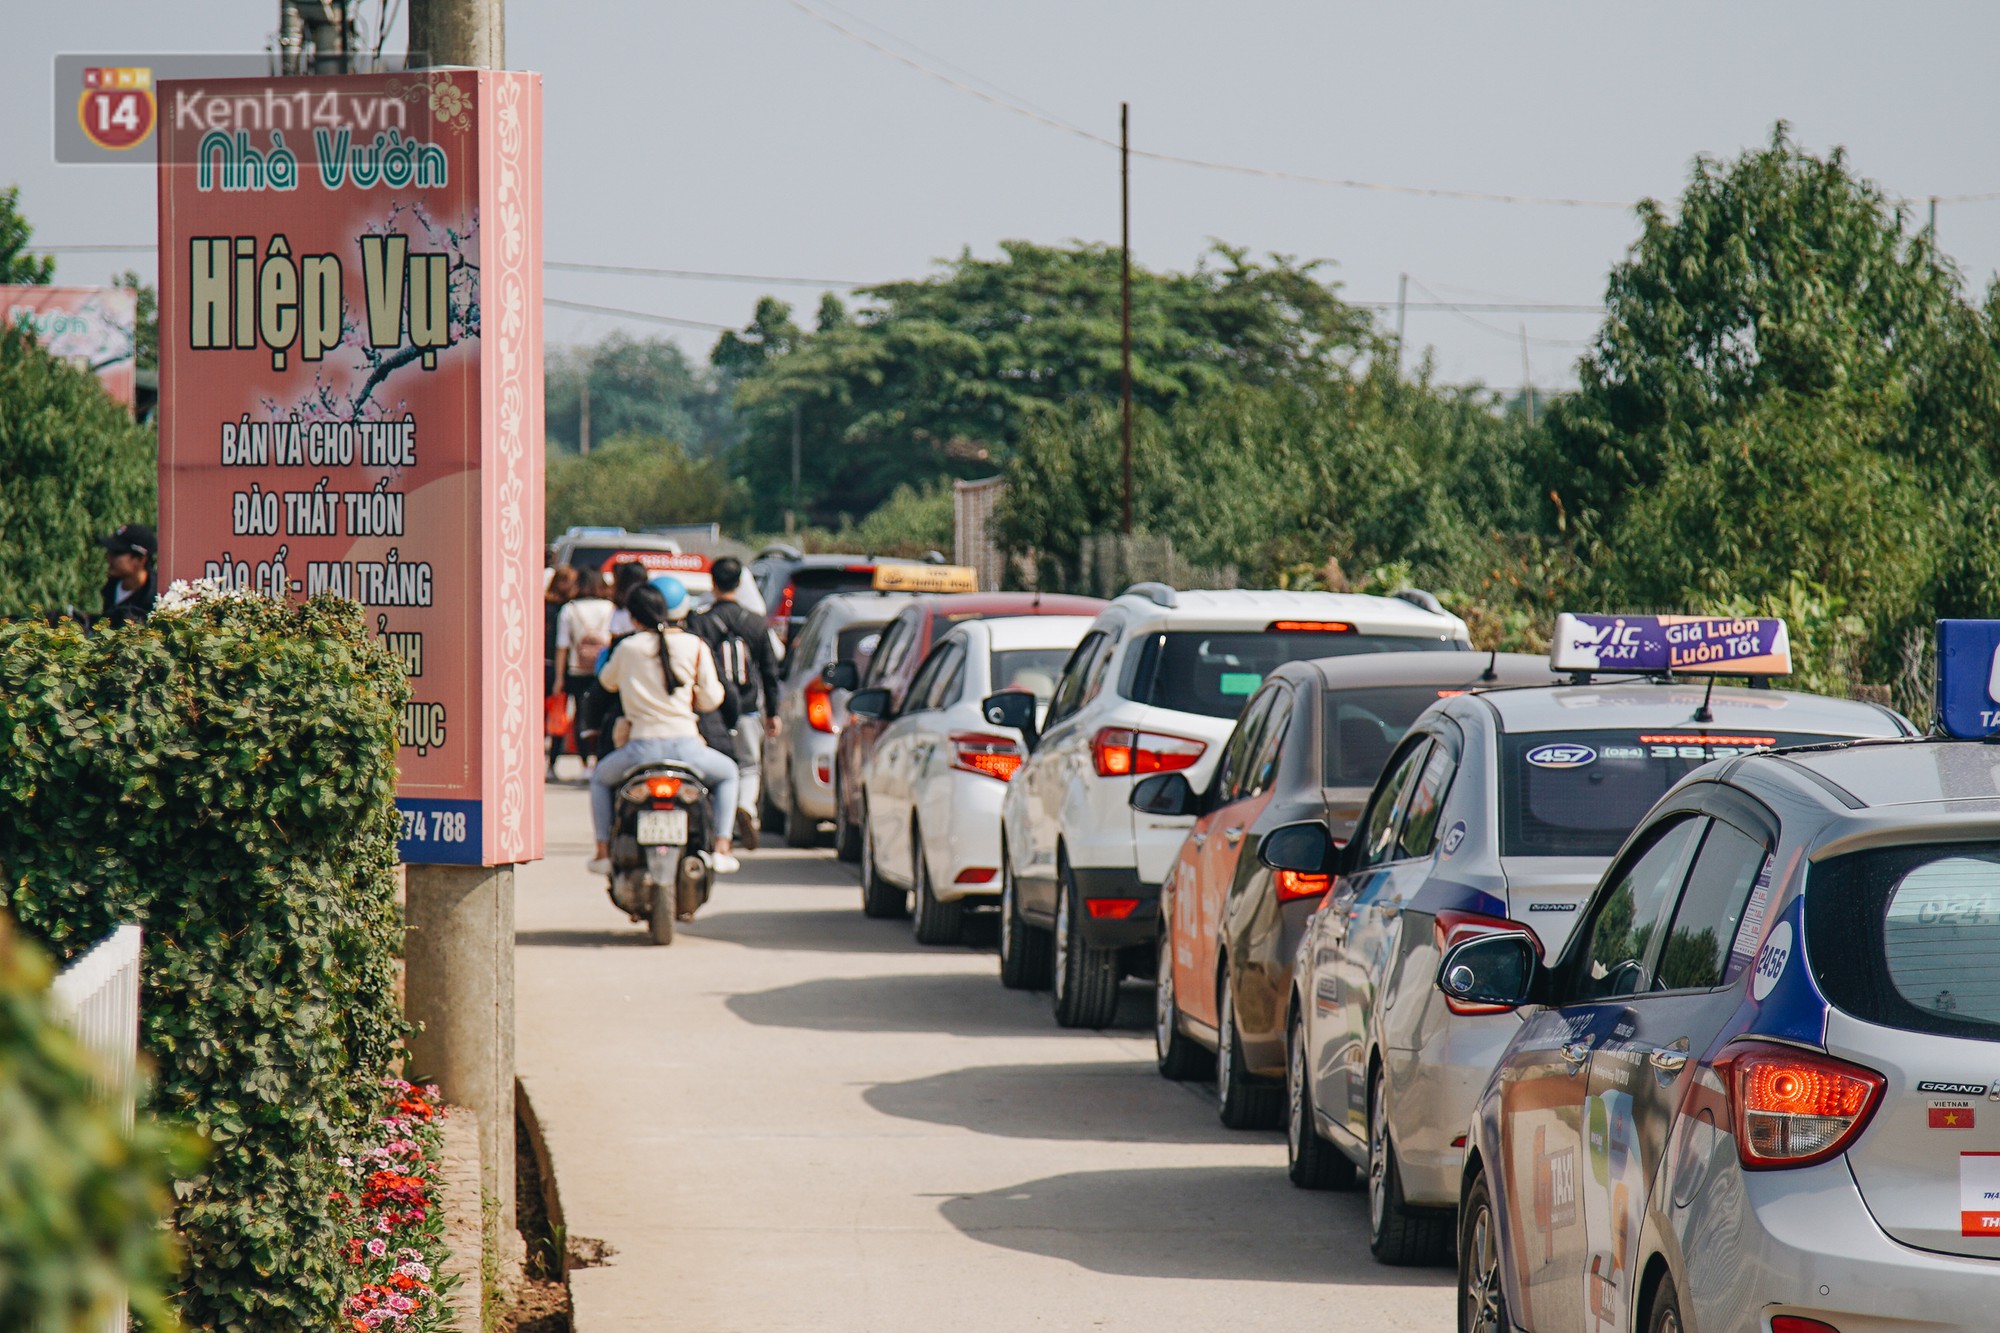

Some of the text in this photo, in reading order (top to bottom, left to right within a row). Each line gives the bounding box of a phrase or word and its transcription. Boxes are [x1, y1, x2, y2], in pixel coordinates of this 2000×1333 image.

[197, 125, 448, 191] Nhà Vườn
[190, 234, 450, 371] Hiệp Vụ
[222, 413, 416, 466] BÁN VÀ CHO THUÊ
[233, 477, 404, 535] ĐÀO THẤT THỐN
[356, 548, 432, 606] TRẮNG
[1666, 621, 1702, 644] Giá
[1707, 618, 1760, 639] Luôn
[1671, 641, 1723, 666] Luôn
[1726, 632, 1760, 657] Tốt
[1534, 749, 1588, 762] 457
[1604, 746, 1643, 758] (024)
[431, 811, 467, 842] 788
[1756, 944, 1787, 979] 2456
[1921, 1082, 1985, 1094] GRAND
[1550, 1152, 1574, 1207] TAXI
